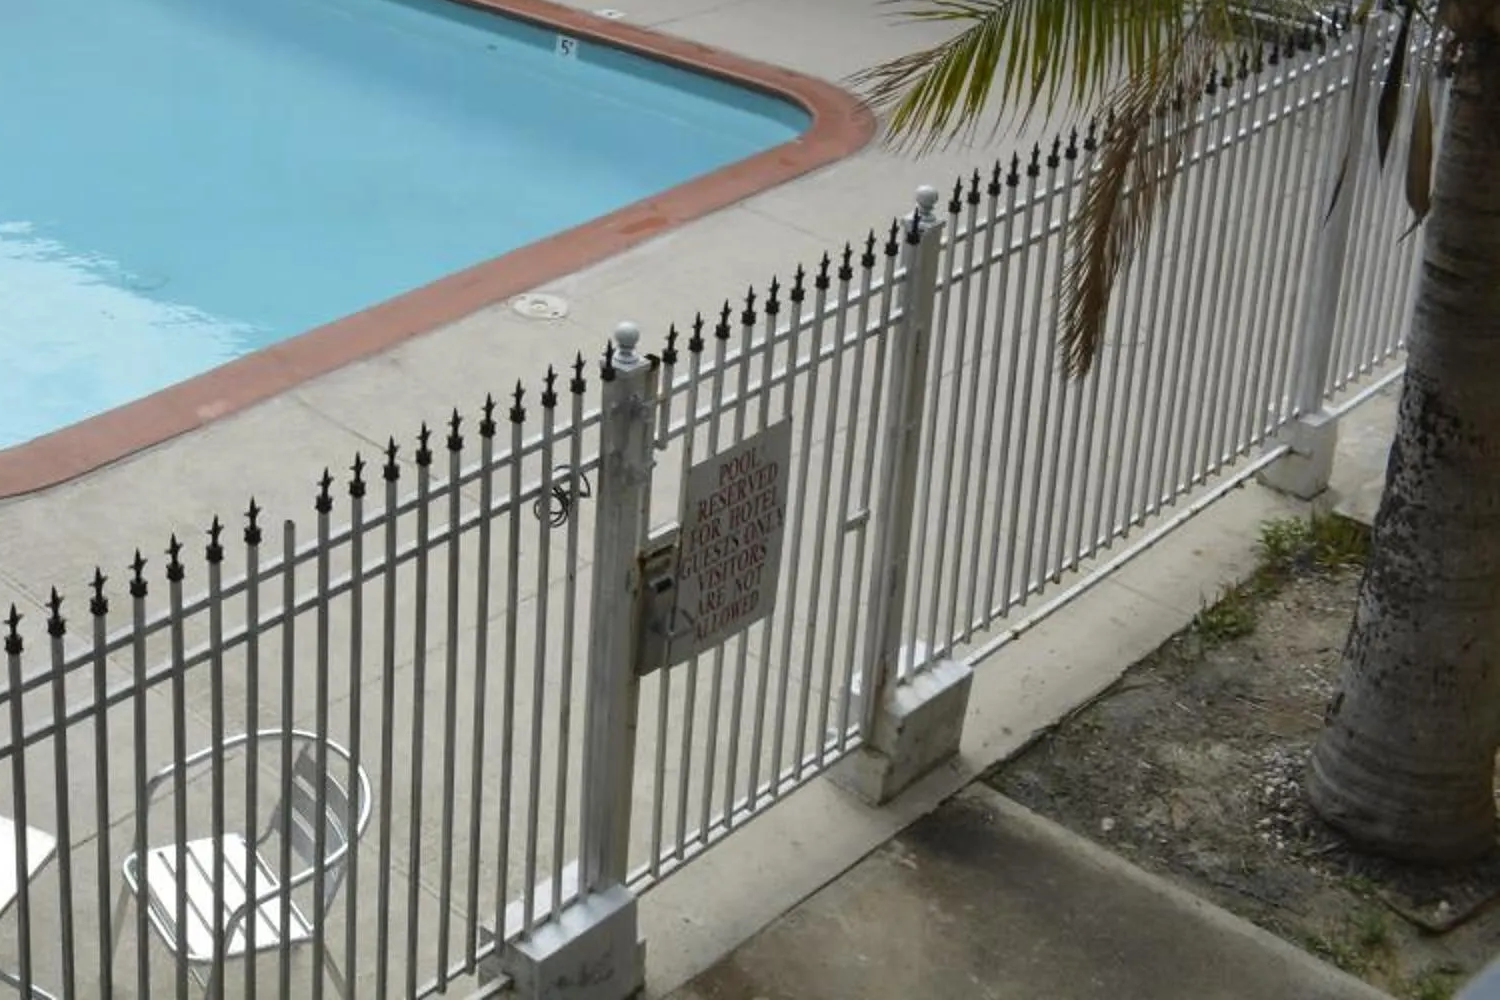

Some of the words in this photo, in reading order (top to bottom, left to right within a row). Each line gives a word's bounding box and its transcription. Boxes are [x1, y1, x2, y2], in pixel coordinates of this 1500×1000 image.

[719, 447, 760, 485] POOL
[697, 462, 779, 523] RESERVED
[682, 532, 740, 581] GUESTS
[742, 503, 786, 545] ONLY
[689, 517, 721, 551] FOR
[697, 544, 768, 591] VISITORS
[697, 585, 727, 617] ARE
[735, 563, 766, 594] NOT
[693, 590, 760, 642] ALLOWED
